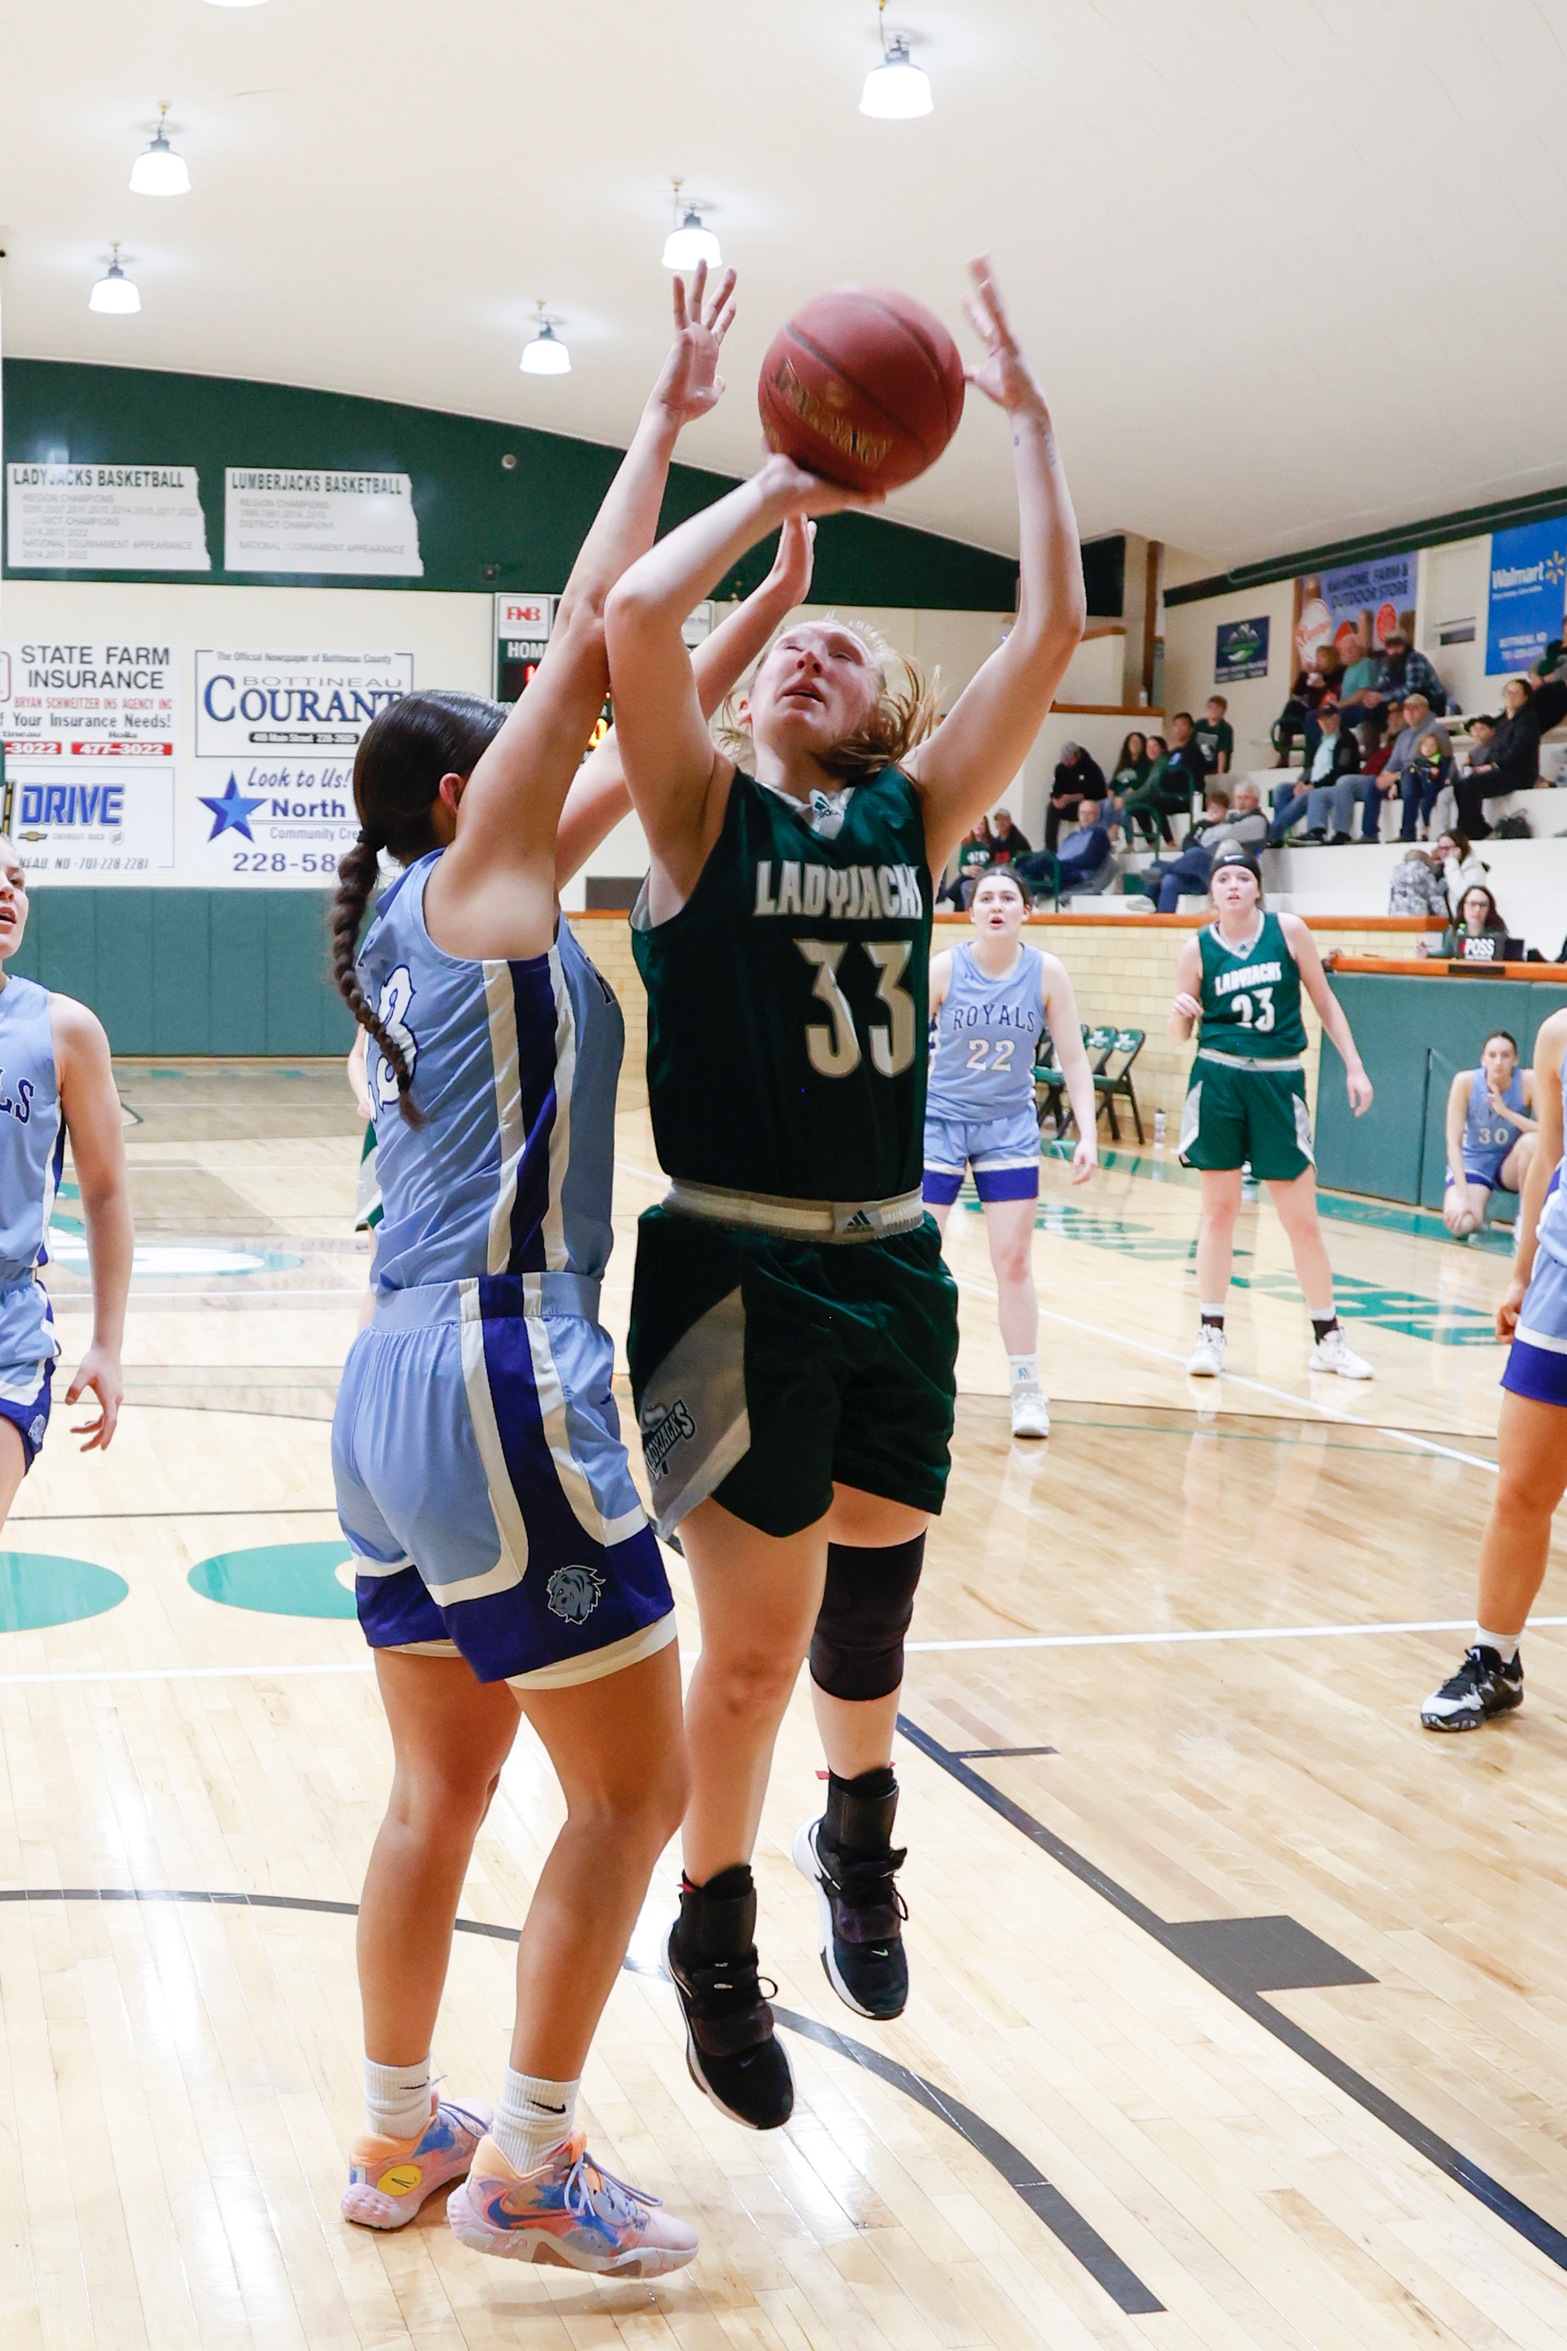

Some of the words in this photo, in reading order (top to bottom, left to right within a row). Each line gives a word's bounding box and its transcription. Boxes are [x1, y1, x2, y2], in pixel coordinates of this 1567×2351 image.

[13, 468, 92, 486] LADYJACKS
[98, 469, 184, 488] BASKETBALL
[232, 472, 320, 492] LUMBERJACKS
[325, 475, 402, 495] BASKETBALL
[507, 606, 541, 622] FNB
[21, 645, 93, 664] STATE
[106, 647, 170, 665] FARM
[28, 669, 164, 689] INSURANCE
[243, 676, 402, 688] BOTTINEAU
[14, 696, 42, 708] BRYAN
[46, 696, 99, 709] SCHWEITZER
[122, 698, 153, 710] AGENCY
[159, 698, 172, 710] INC
[13, 712, 42, 727] Your
[50, 712, 117, 728] Insurance
[124, 713, 171, 728] Needs!
[80, 743, 164, 754] 477-3022
[247, 766, 291, 787] Look
[297, 767, 315, 788] to
[321, 767, 352, 788] Us!
[20, 783, 125, 826] DRIVE
[271, 799, 346, 818] North
[270, 827, 334, 841] Community
[55, 857, 70, 869] ND
[1214, 961, 1282, 996] LADYJACKS
[793, 937, 916, 1079] 33
[953, 1003, 1035, 1033] ROYALS
[1230, 986, 1275, 1032] 23
[966, 1038, 1016, 1072] 22
[1479, 1127, 1509, 1145] 30
